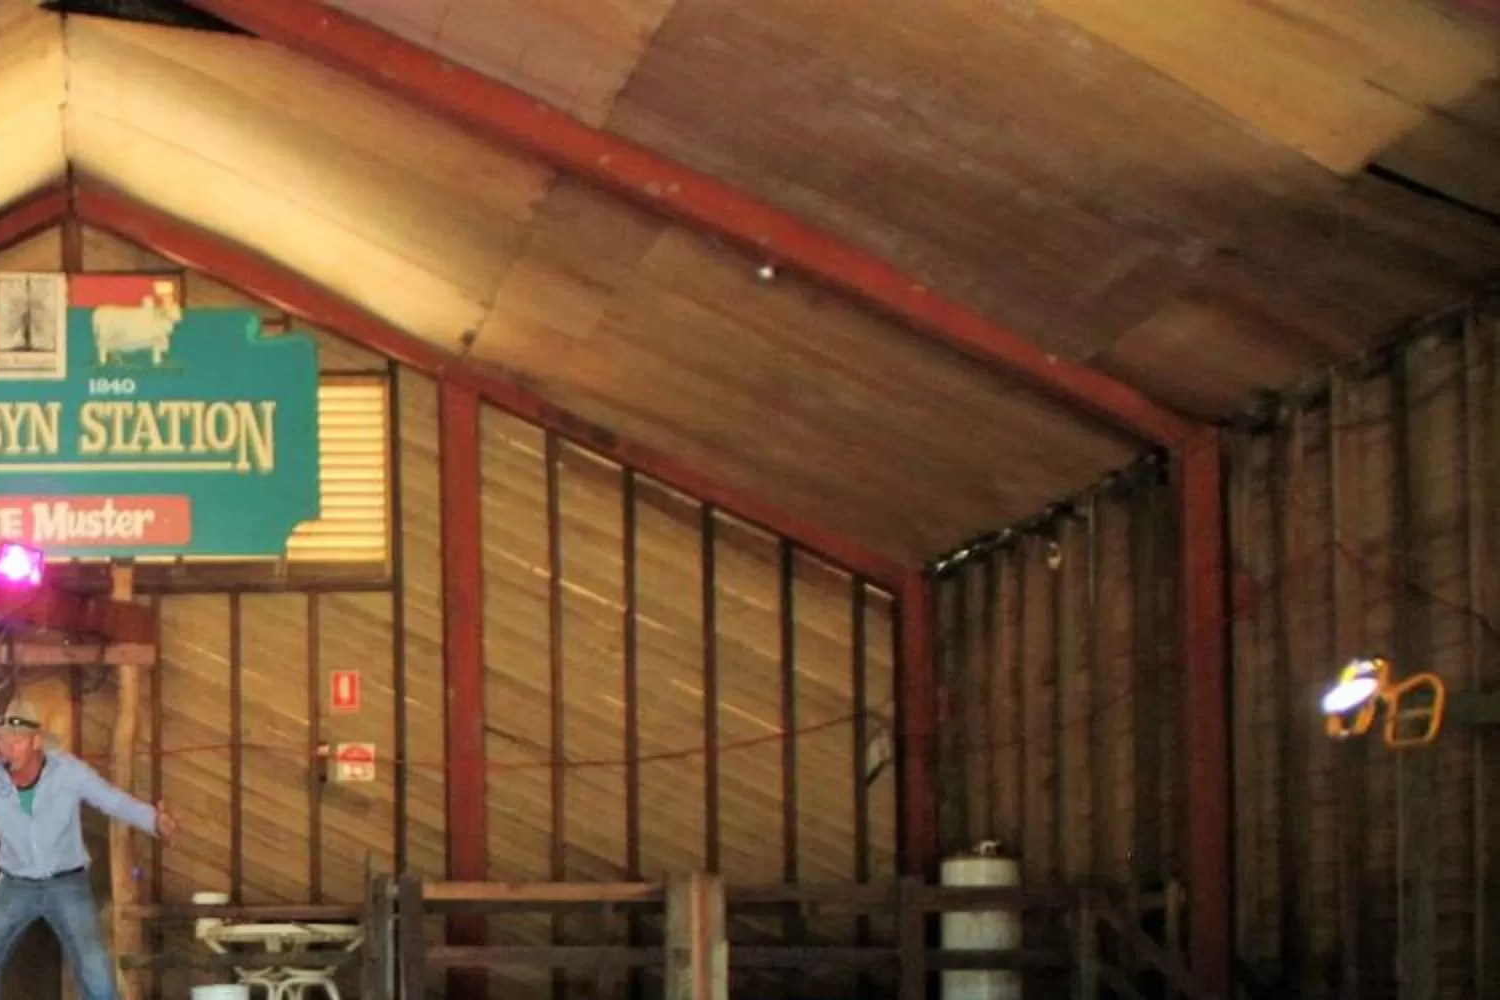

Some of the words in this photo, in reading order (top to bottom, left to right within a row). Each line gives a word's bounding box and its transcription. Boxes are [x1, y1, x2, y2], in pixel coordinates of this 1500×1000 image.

[88, 378, 137, 396] 1840
[80, 400, 276, 473] STATION
[31, 497, 155, 541] Muster
